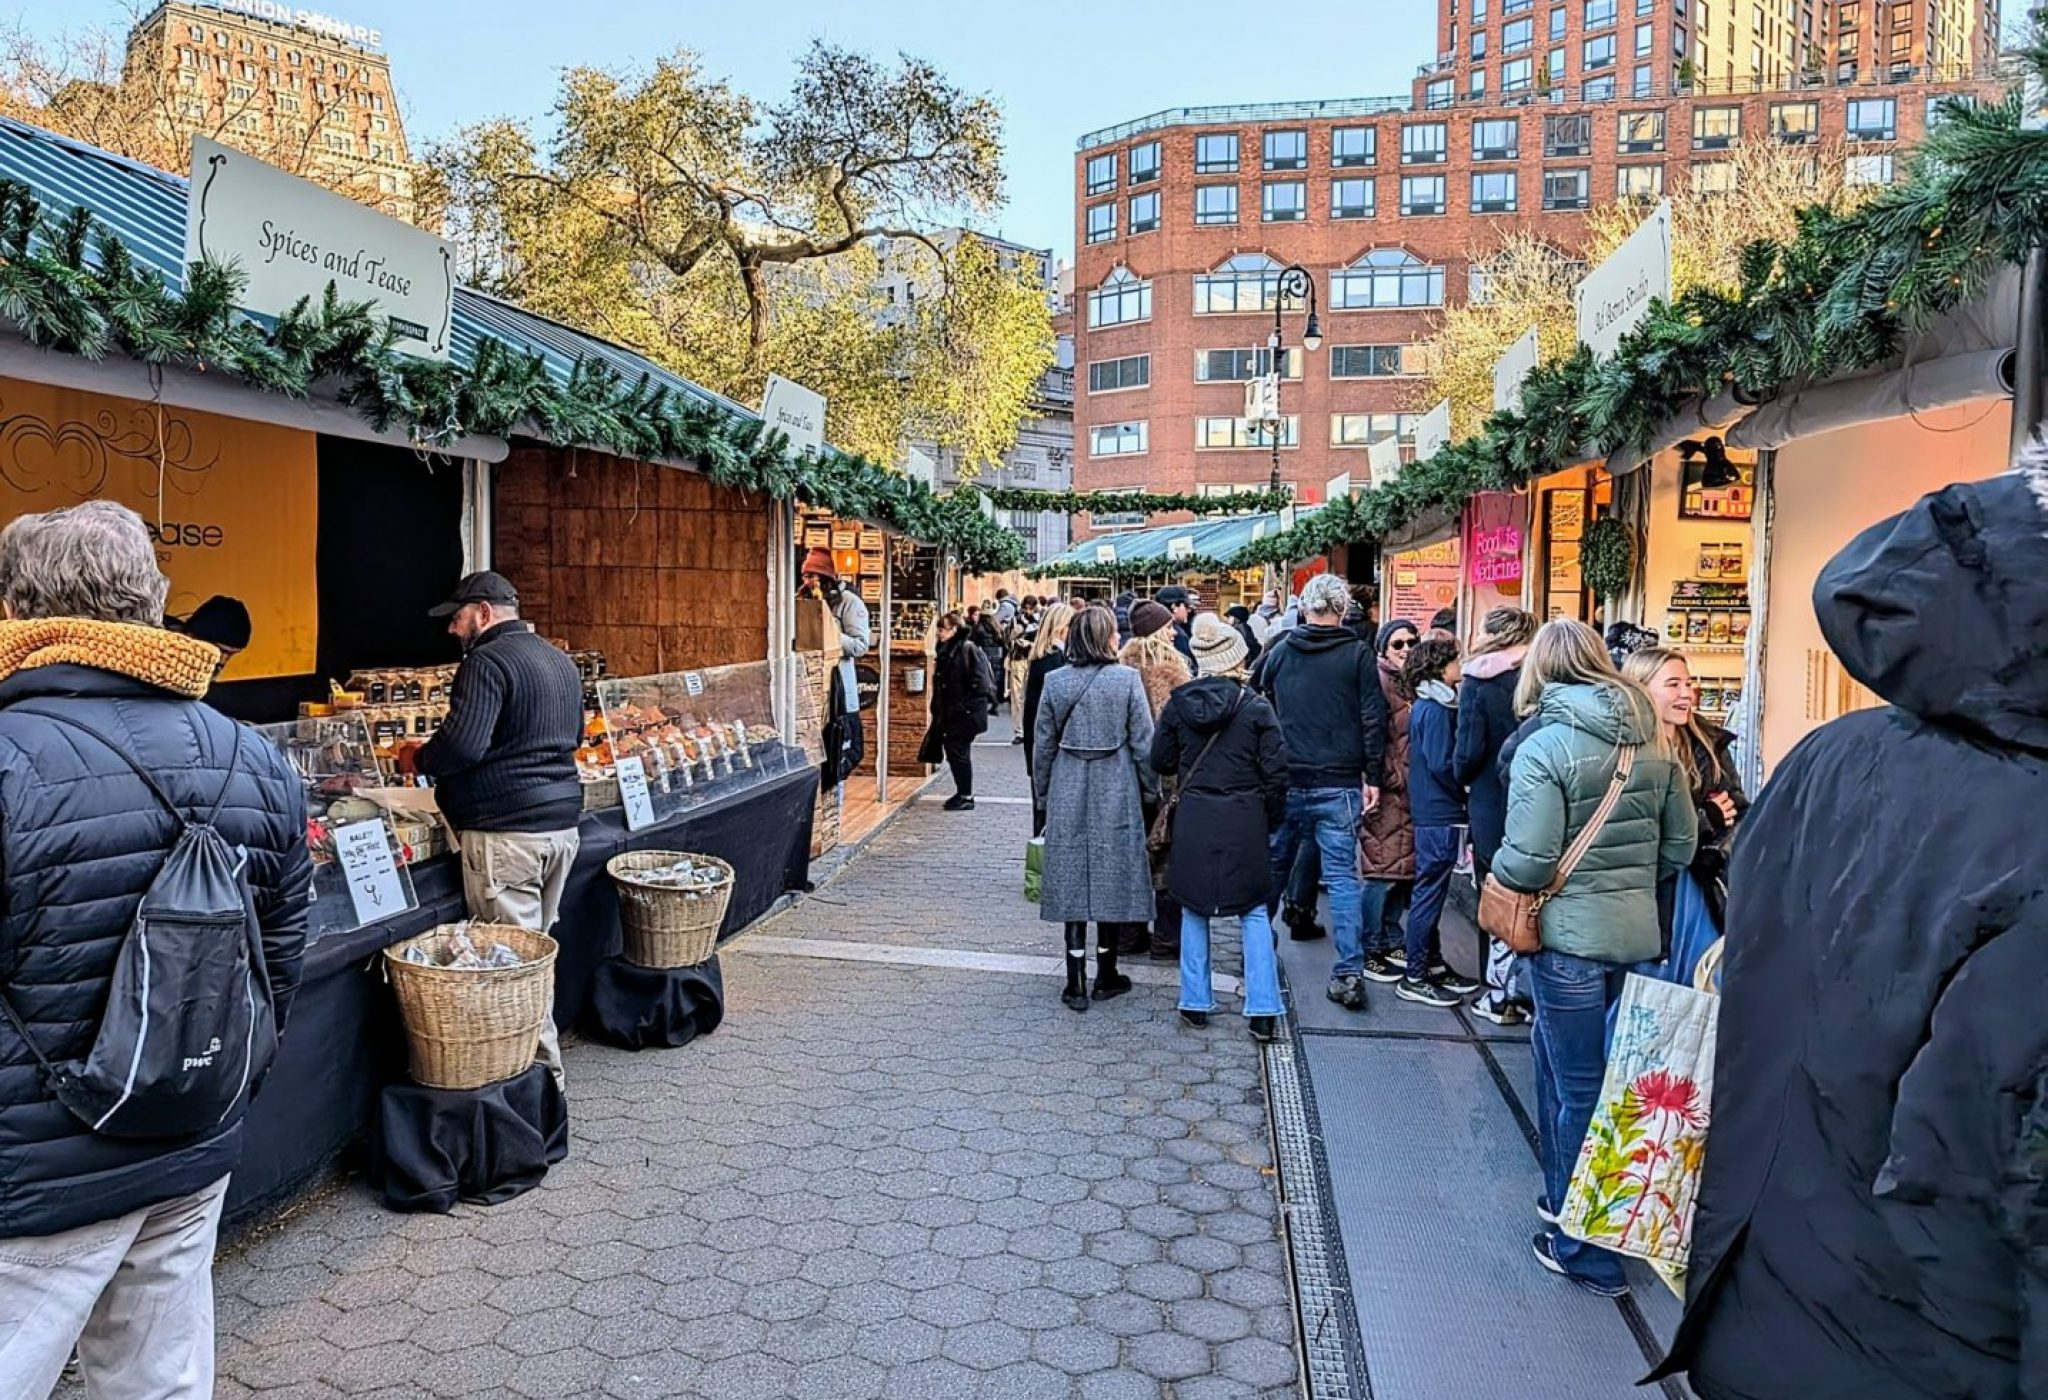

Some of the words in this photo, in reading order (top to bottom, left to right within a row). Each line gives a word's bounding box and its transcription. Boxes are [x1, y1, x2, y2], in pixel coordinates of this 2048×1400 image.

[222, 0, 291, 22] UNION
[296, 9, 382, 47] SQUARE
[259, 220, 318, 263] Spices
[324, 250, 364, 278] and
[365, 257, 411, 296] Tease
[143, 520, 223, 547] ease
[1476, 528, 1500, 554] Food
[1505, 527, 1519, 548] is
[183, 1056, 213, 1071] pwc
